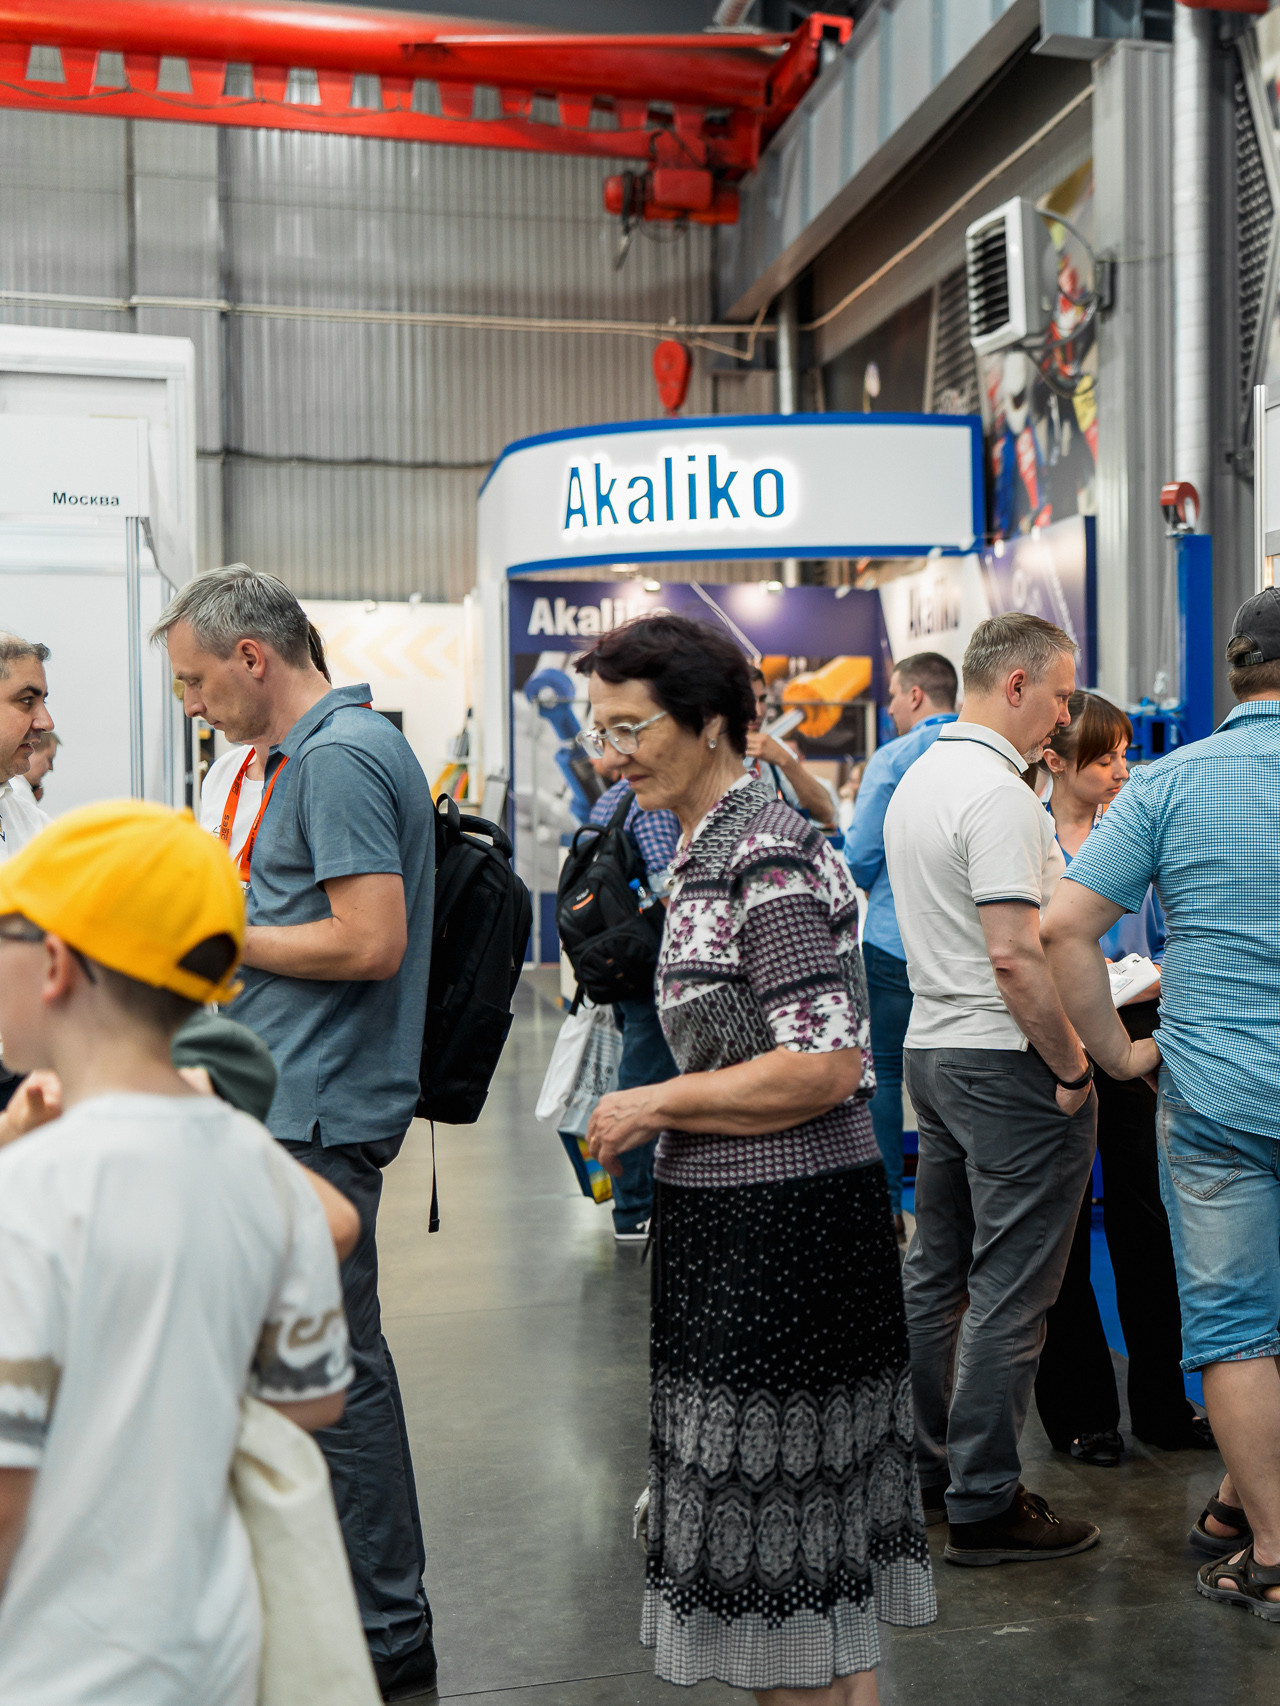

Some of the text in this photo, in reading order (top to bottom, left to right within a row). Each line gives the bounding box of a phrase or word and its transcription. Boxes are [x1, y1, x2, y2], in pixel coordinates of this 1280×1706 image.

[53, 491, 120, 507] Москва
[564, 454, 785, 530] Akaliko
[527, 597, 672, 637] Akali
